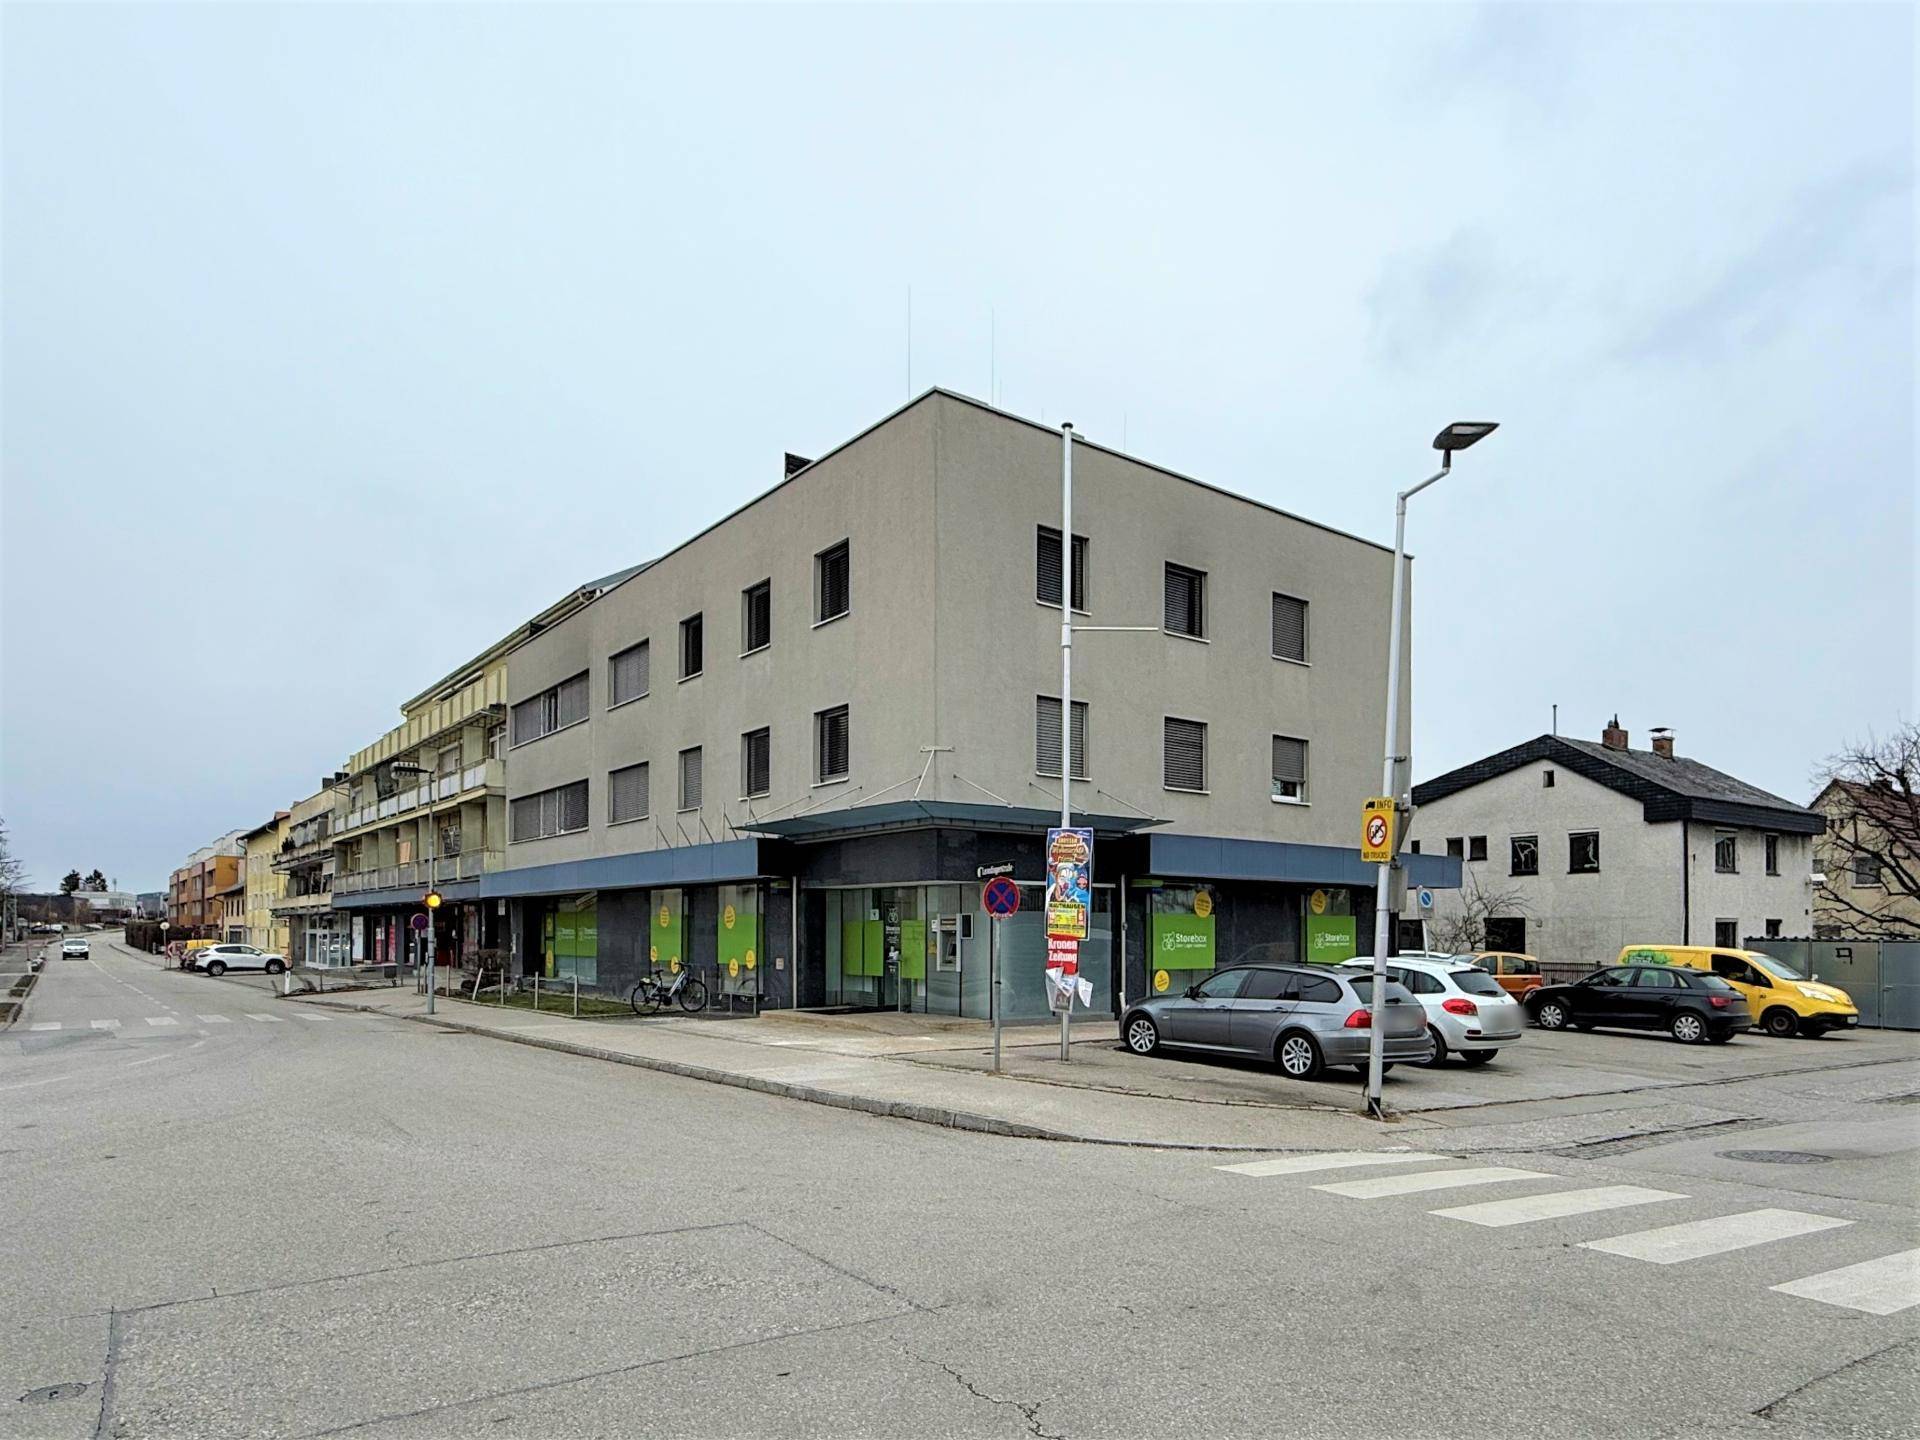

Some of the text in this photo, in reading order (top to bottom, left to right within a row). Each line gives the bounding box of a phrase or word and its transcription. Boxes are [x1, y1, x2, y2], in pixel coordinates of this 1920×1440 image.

[1376, 799, 1392, 809] INFO
[1175, 933, 1207, 942] Storebox
[1048, 938, 1078, 950] Kronen
[1048, 950, 1077, 964] Zeitung
